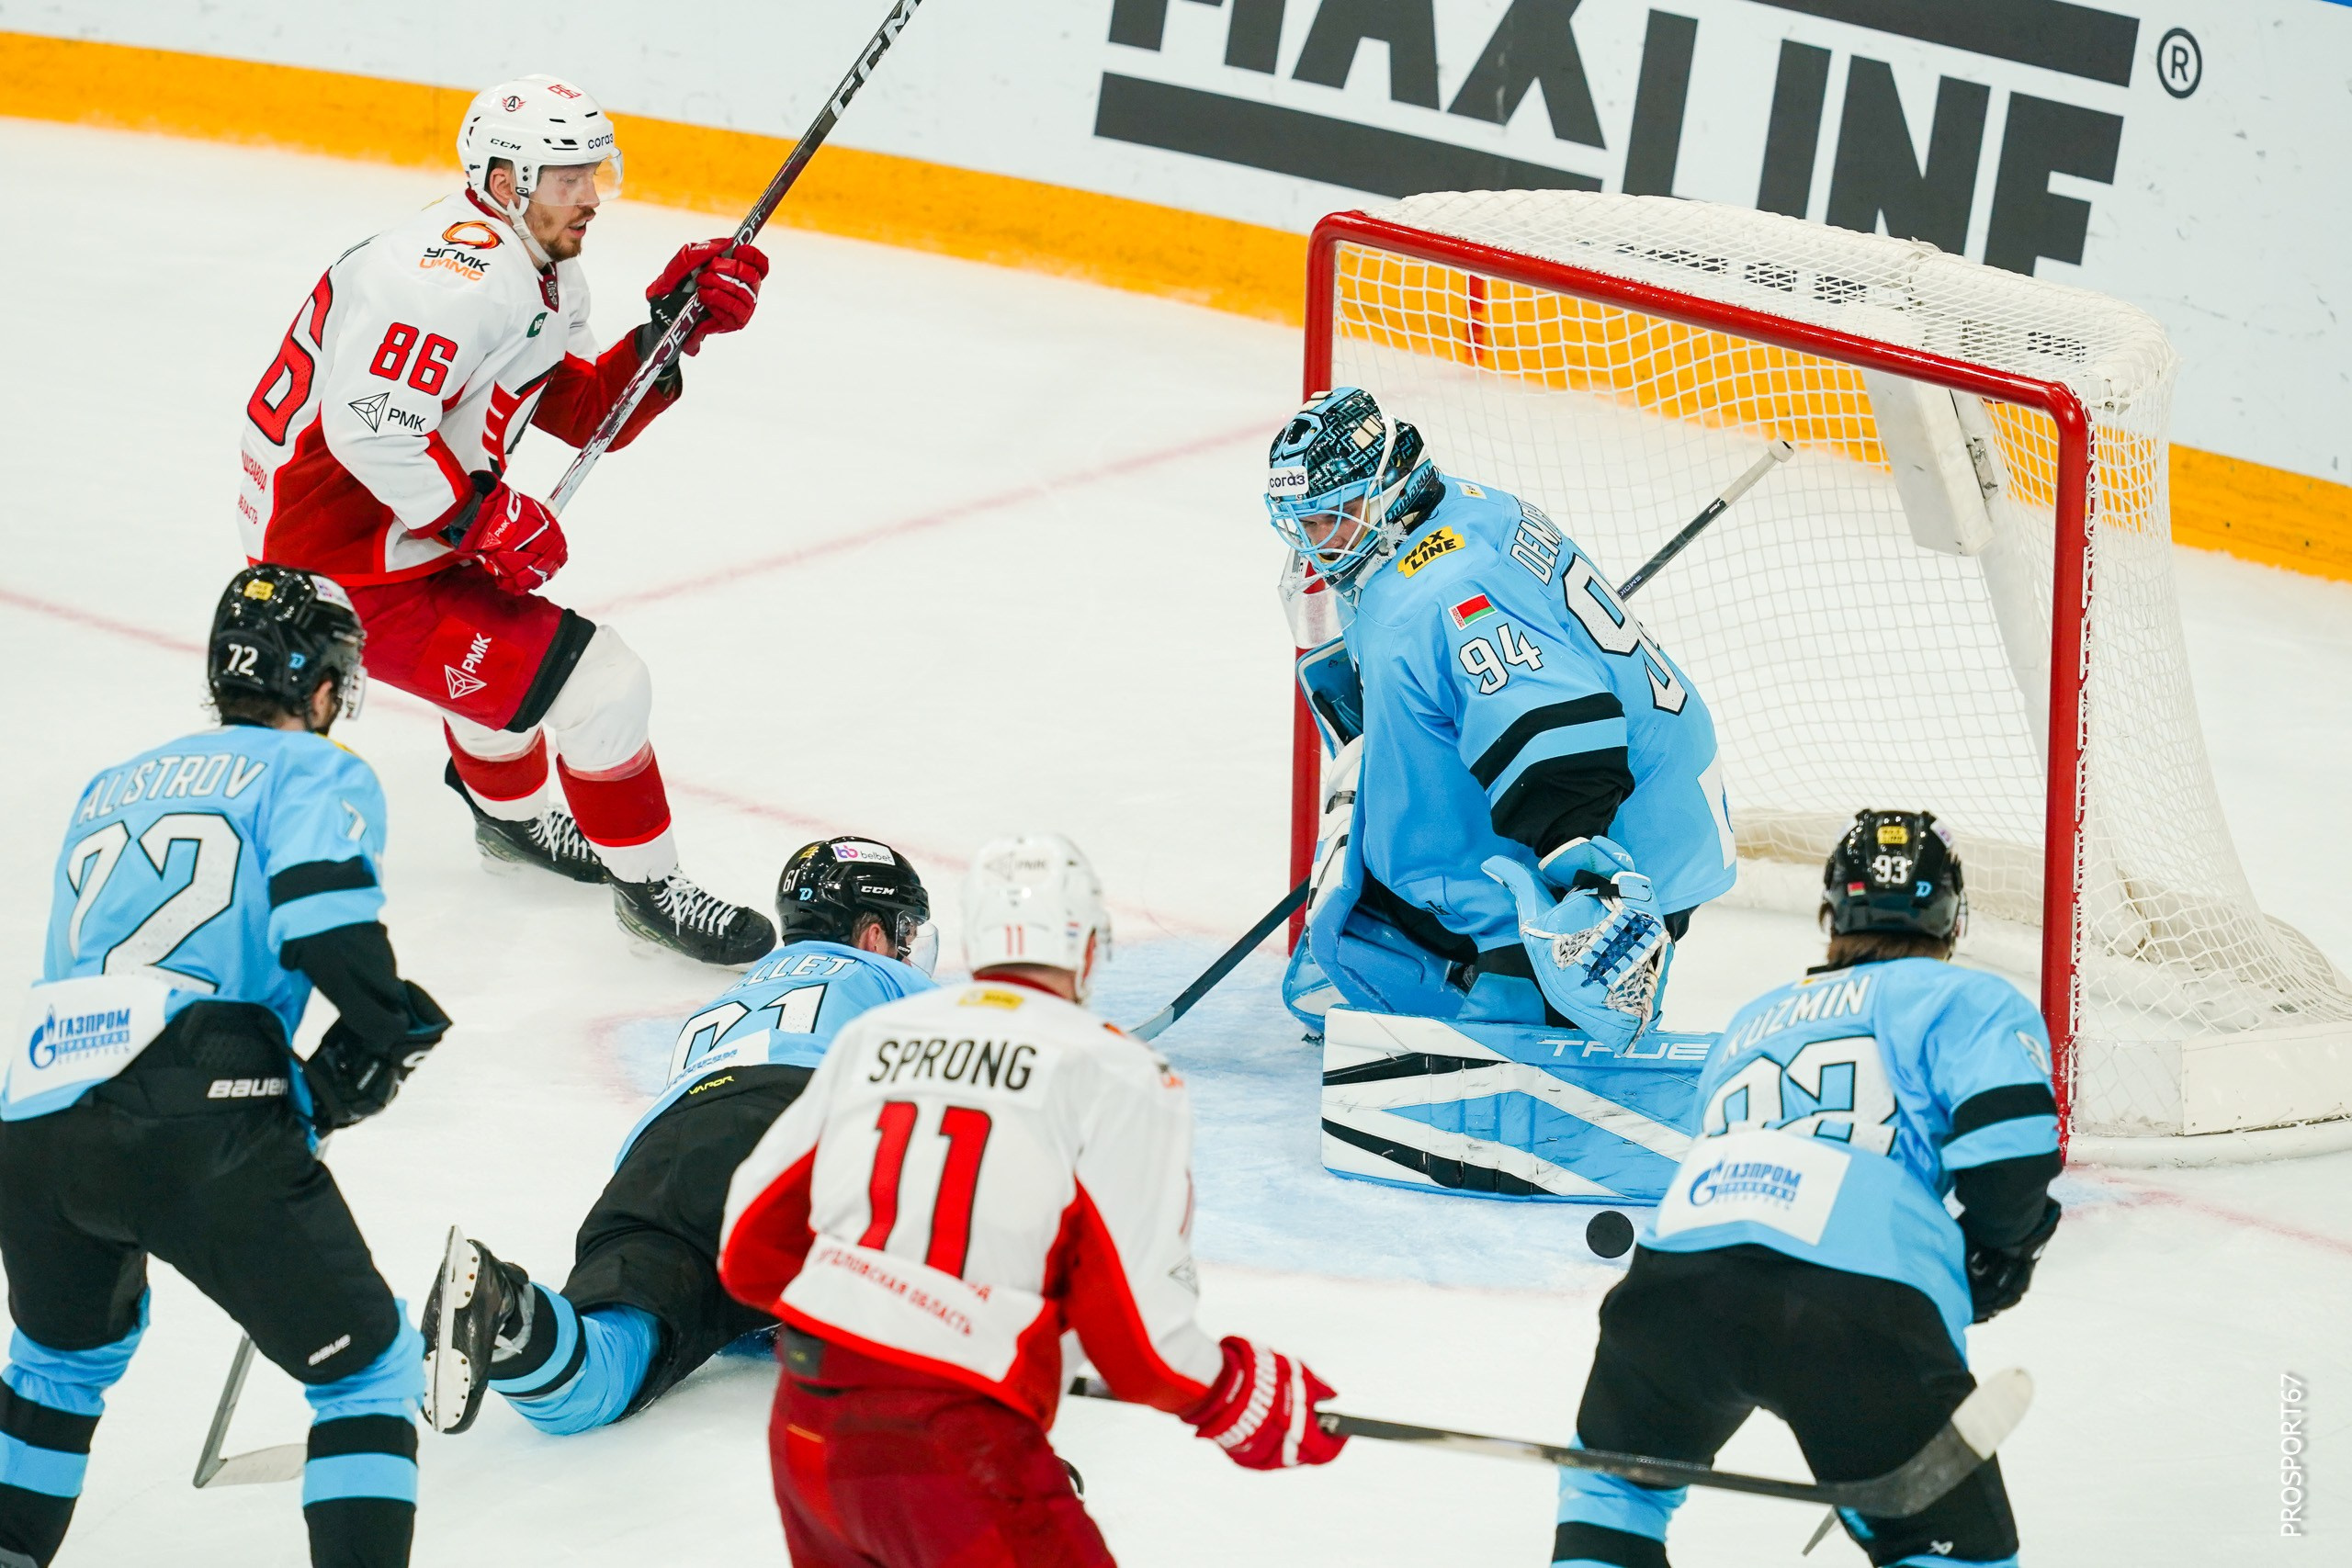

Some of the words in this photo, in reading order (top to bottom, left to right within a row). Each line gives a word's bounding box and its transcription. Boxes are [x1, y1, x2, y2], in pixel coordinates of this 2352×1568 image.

[490, 138, 522, 151] CCM
[419, 258, 485, 281] UMMC
[424, 247, 491, 272] УГМК
[368, 321, 458, 396] 86
[388, 408, 427, 433] РМК
[1269, 475, 1306, 488] согаз
[495, 520, 511, 537] РМК
[1404, 530, 1445, 565] MAX
[1410, 538, 1457, 570] LINE
[228, 643, 259, 676] 72
[461, 632, 492, 674] РМК
[1458, 623, 1544, 695] 94
[77, 753, 267, 826] ALISTROV
[860, 851, 893, 863] belbet
[1873, 854, 1908, 885] 93
[782, 868, 800, 892] 61
[860, 885, 897, 896] CCM
[67, 812, 243, 994] 72
[1005, 924, 1024, 956] 11
[59, 1008, 130, 1039] ГАЗПРОМ
[1721, 974, 1872, 1066] KUZMIN
[868, 1036, 1037, 1092] SPRONG
[689, 1075, 735, 1095] VAPOR
[857, 1100, 992, 1279] 11
[1723, 1163, 1802, 1188] ГАЗПРОМ
